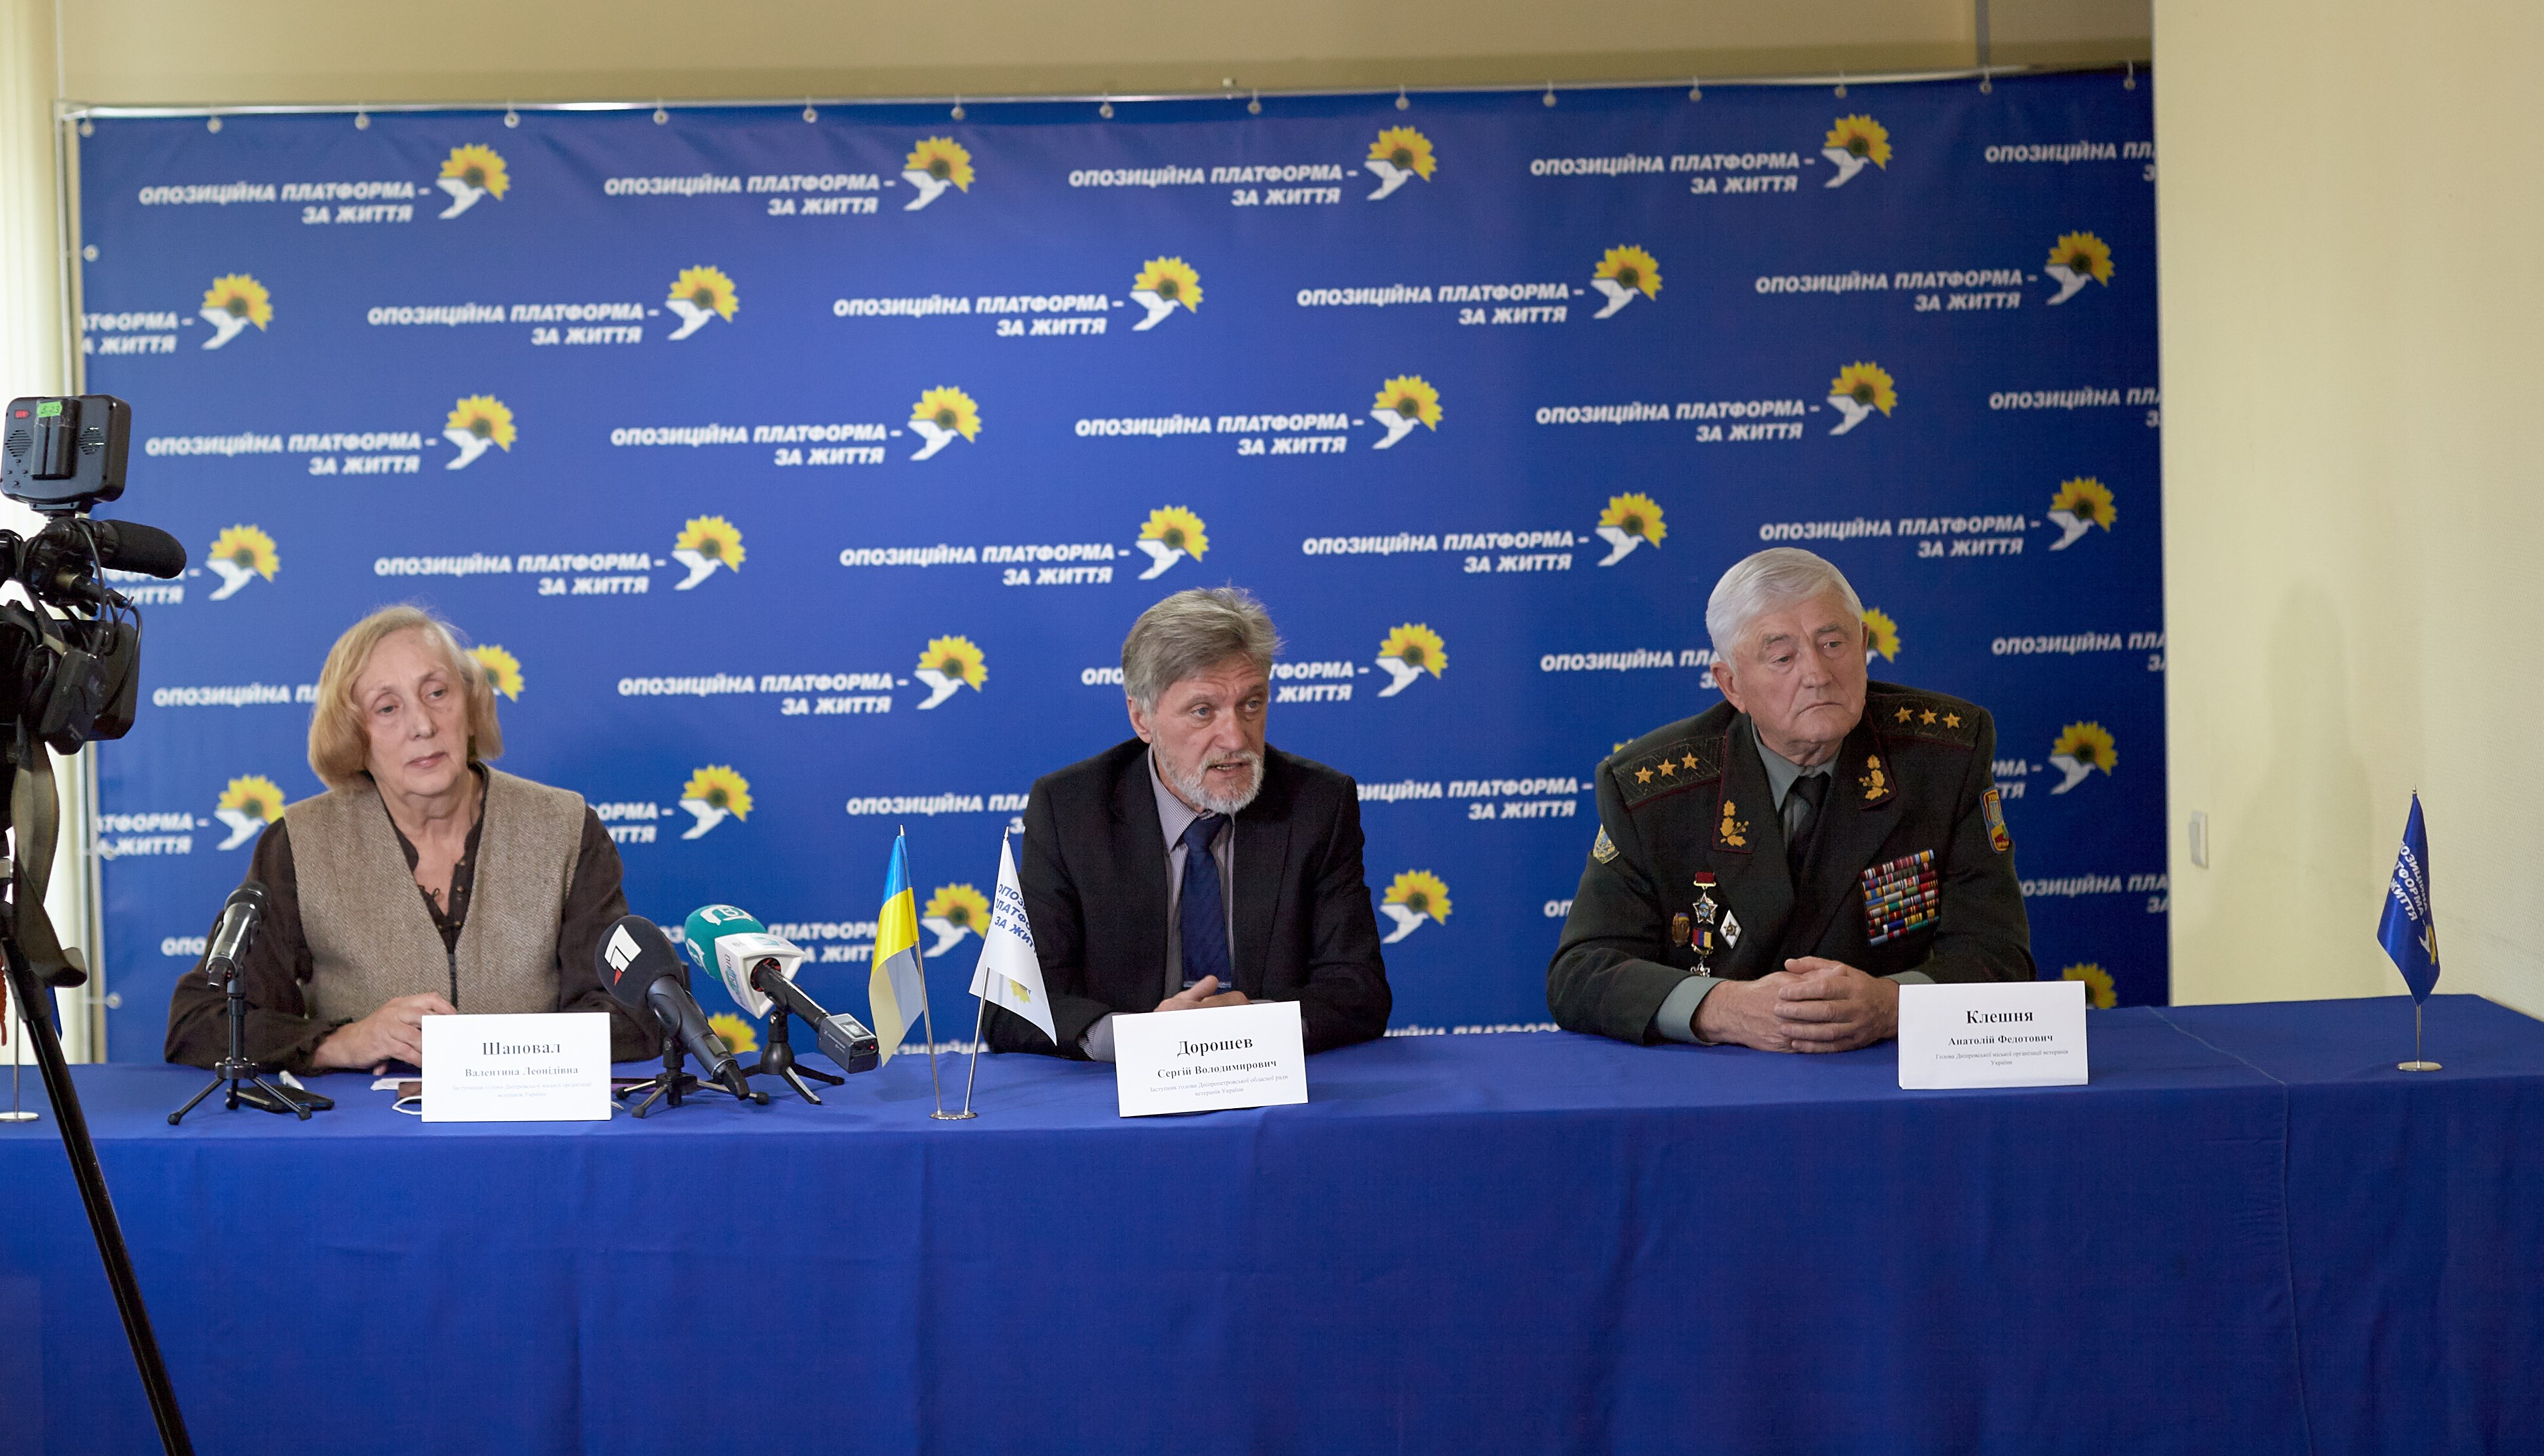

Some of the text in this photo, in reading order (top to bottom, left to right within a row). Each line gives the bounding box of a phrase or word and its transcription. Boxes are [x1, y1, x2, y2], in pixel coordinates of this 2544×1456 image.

[1985, 140, 2117, 164] ОПОЗИЦІЙНА
[1530, 154, 1664, 176] ОПОЗИЦІЙНА
[1670, 153, 1799, 172] ПЛАТФОРМА
[604, 174, 741, 196] ОПОЗИЦІЙНА
[747, 174, 879, 192] ПЛАТФОРМА
[1069, 165, 1205, 187] ОПОЗИЦІЙНА
[1211, 164, 1342, 183] ПЛАТФОРМА
[1691, 176, 1797, 193] ЗА ЖИТТЯ
[139, 181, 276, 204] ОПОЗИЦІЙНА
[281, 182, 414, 201] ПЛАТФОРМА
[1232, 187, 1341, 206] ЗА ЖИТТЯ
[303, 205, 413, 224] ЗА ЖИТТЯ
[768, 197, 878, 215] ЗА ЖИТТЯ
[1755, 271, 1888, 294] ОПОЗИЦІЙНА
[1894, 270, 2023, 288] ПЛАТФОРМА
[1297, 284, 1433, 307] ОПОЗИЦІЙНА
[1438, 283, 1569, 302] ПЛАТФОРМА
[1915, 292, 2021, 311] ЗА ЖИТТЯ
[367, 303, 505, 326] ОПОЗИЦІЙНА
[510, 303, 644, 322] ПЛАТФОРМА
[833, 294, 970, 318] ОПОЗИЦІЙНА
[976, 294, 1109, 313] ПЛАТФОРМА
[1459, 306, 1567, 324] ЗА ЖИТТЯ
[531, 326, 642, 345] ЗА ЖИТТЯ
[997, 318, 1107, 337] ЗА ЖИТТЯ
[99, 334, 177, 354] ЖИТТЯ
[1990, 386, 2120, 410] ОПОЗИЦІЙНА
[1536, 401, 1669, 425] ОПОЗИЦІЙНА
[1675, 399, 1805, 420] ПЛАТФОРМА
[1075, 414, 1211, 437] ОПОЗИЦІЙНА
[1217, 413, 1348, 433] ПЛАТФОРМА
[1696, 422, 1803, 442] ЗА ЖИТТЯ
[146, 433, 283, 456] ОПОЗИЦІЙНА
[288, 432, 421, 452] ПЛАТФОРМА
[611, 424, 749, 447] ОПОЗИЦІЙНА
[753, 424, 886, 442] ПЛАТФОРМА
[1237, 436, 1347, 456] ЗА ЖИТТЯ
[309, 456, 420, 475] ЗА ЖИТТЯ
[774, 447, 885, 466] ЗА ЖИТТЯ
[1760, 517, 1892, 541] ОПОЗИЦІЙНА
[1898, 515, 2025, 536] ПЛАТФОРМА
[1303, 533, 1438, 555] ОПОЗИЦІЙНА
[1443, 531, 1574, 550] ПЛАТФОРМА
[1918, 538, 2023, 557] ЗА ЖИТТЯ
[375, 553, 512, 577] ОПОЗИЦІЙНА
[517, 553, 651, 572] ПЛАТФОРМА
[840, 544, 977, 567] ОПОЗИЦІЙНА
[982, 544, 1115, 563] ПЛАТФОРМА
[1463, 553, 1572, 573] ЗА ЖИТТЯ
[538, 576, 649, 595] ЗА ЖИТТЯ
[1002, 566, 1113, 585] ЗА ЖИТТЯ
[1992, 632, 2122, 655] ОПОЗИЦІЙНА
[1540, 649, 1673, 672] ОПОЗИЦІЙНА
[153, 682, 290, 708] ОПОЗИЦІЙНА
[618, 673, 756, 697] ОПОЗИЦІЙНА
[760, 673, 893, 692] ПЛАТФОРМА
[1276, 684, 1352, 703] ЖИТТЯ
[781, 696, 892, 715] ЗА ЖИТТЯ
[1357, 779, 1443, 803] ЗИЦІЙНА
[1448, 777, 1578, 798] ПЛАТФОРМА
[846, 792, 984, 817] ОПОЗИЦІЙНА
[1468, 800, 1576, 820] ЗА ЖИТТЯ
[115, 835, 193, 856] ЖИТТЯ
[2019, 874, 2123, 898] ОЗИЦІЙНА
[995, 916, 1007, 929] ЗА
[1966, 1010, 2034, 1024] Клешня
[483, 1042, 560, 1055] Шаповал
[1177, 1038, 1253, 1057] Дорошев
[1948, 1035, 2053, 1046] Анатолій Федотович
[1158, 1060, 1277, 1079] Сергій Володимирович
